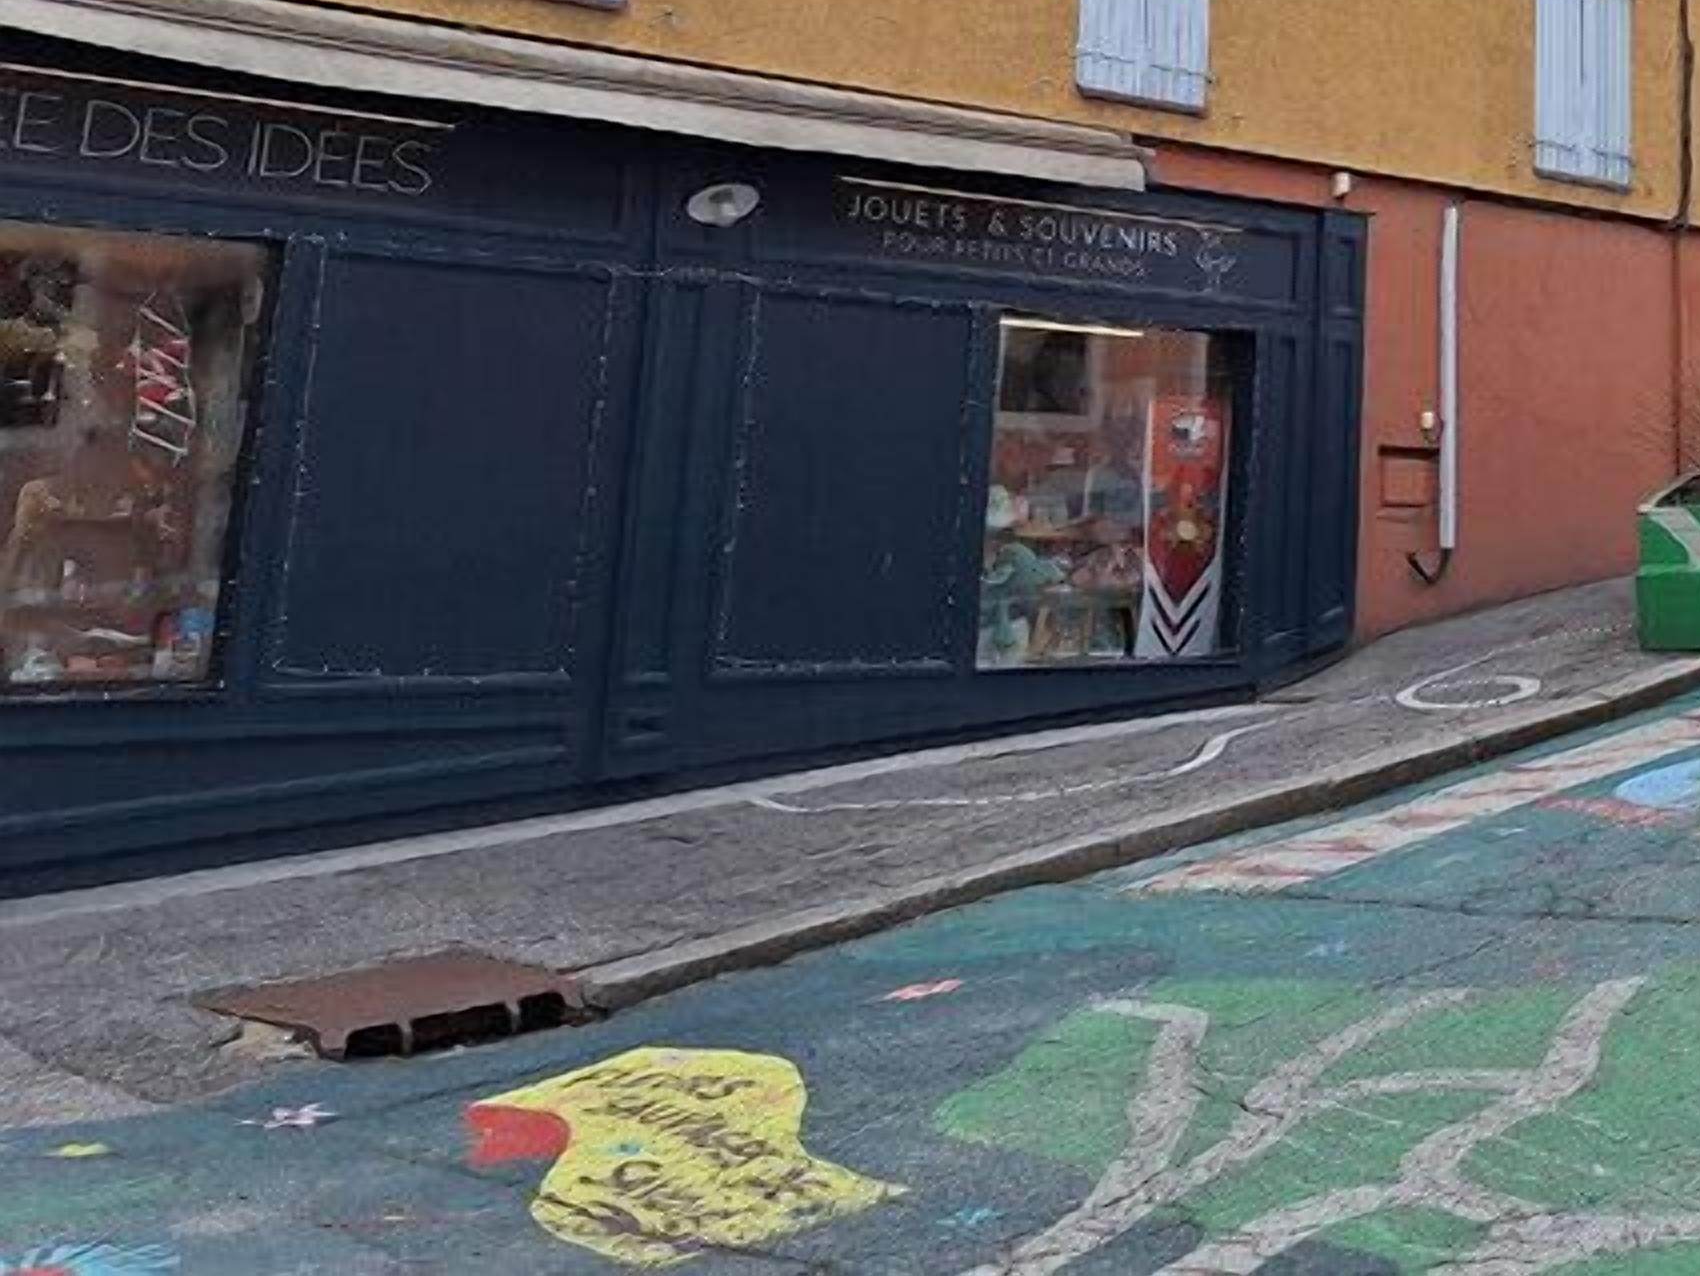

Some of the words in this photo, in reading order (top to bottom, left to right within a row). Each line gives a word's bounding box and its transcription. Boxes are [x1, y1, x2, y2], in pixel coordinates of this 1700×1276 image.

[0, 87, 63, 154] E
[79, 99, 229, 171] DES
[847, 195, 966, 232] JOUETS
[987, 210, 1008, 237] &
[1020, 215, 1177, 258] SOUVENIRS
